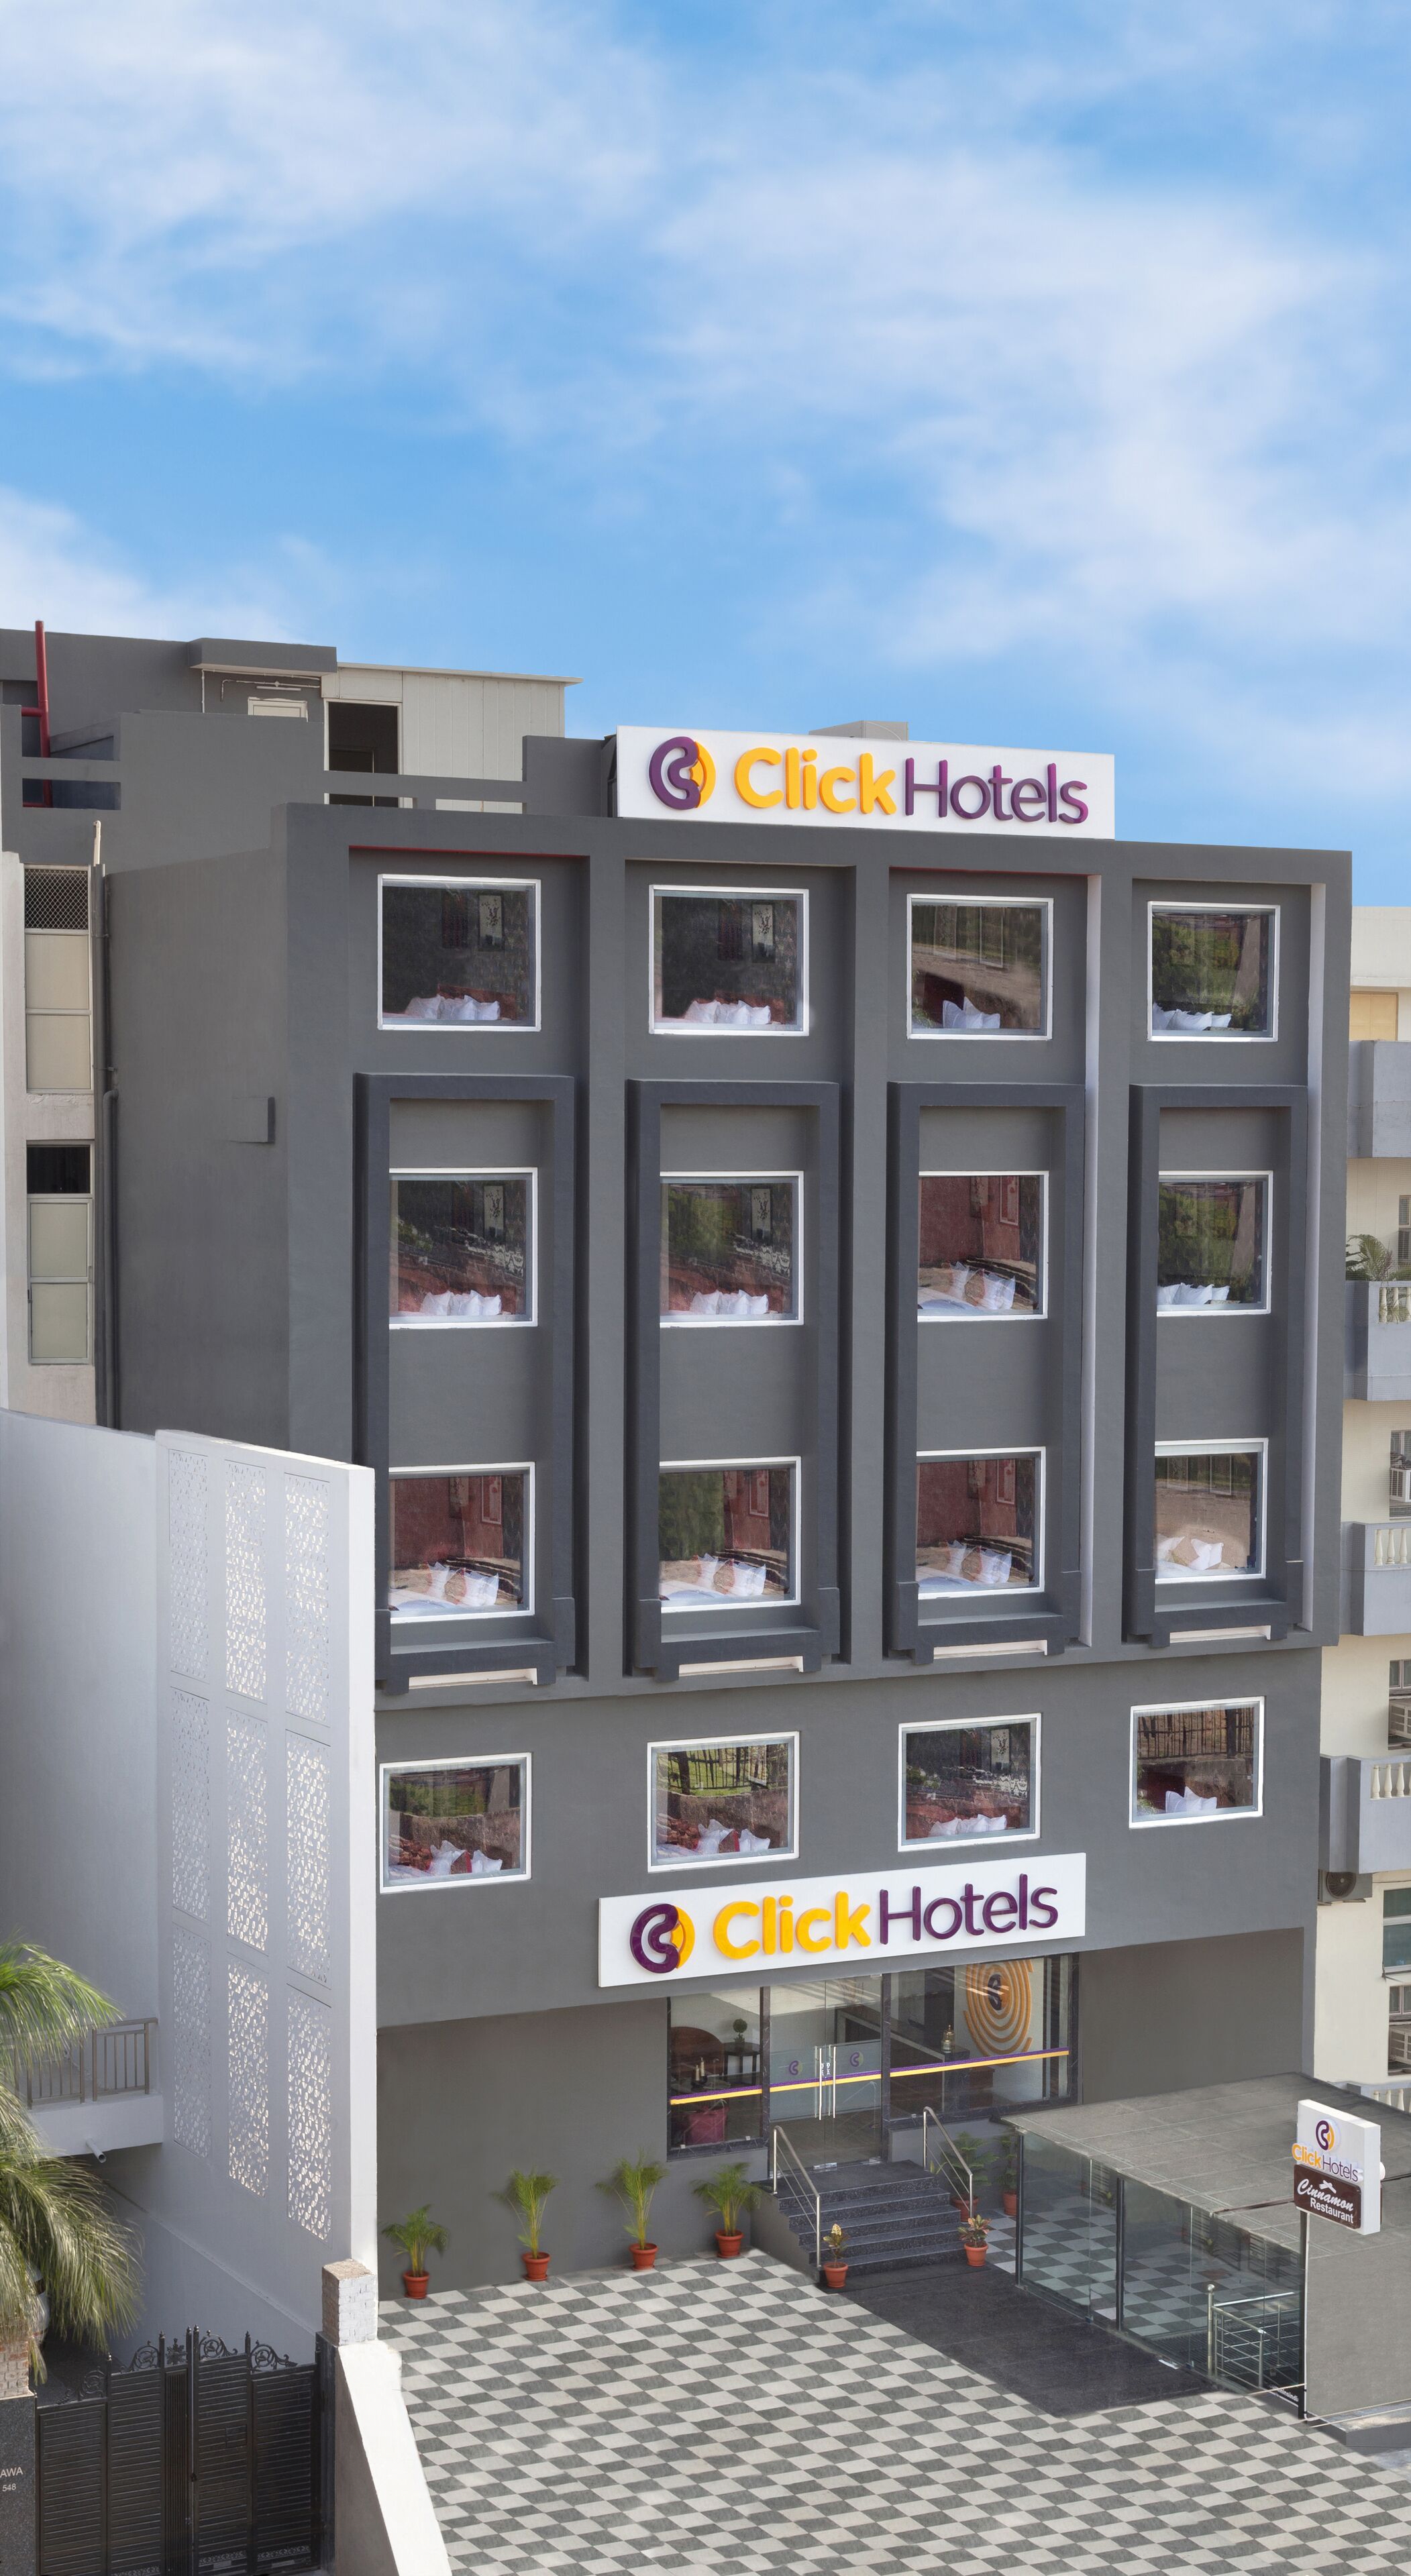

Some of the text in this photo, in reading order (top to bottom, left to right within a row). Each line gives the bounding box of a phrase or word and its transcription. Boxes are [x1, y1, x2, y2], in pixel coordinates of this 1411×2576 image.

[1297, 2178, 1354, 2212] Cinnamon
[1310, 2197, 1354, 2224] Restaurant
[2, 2483, 17, 2492] 548
